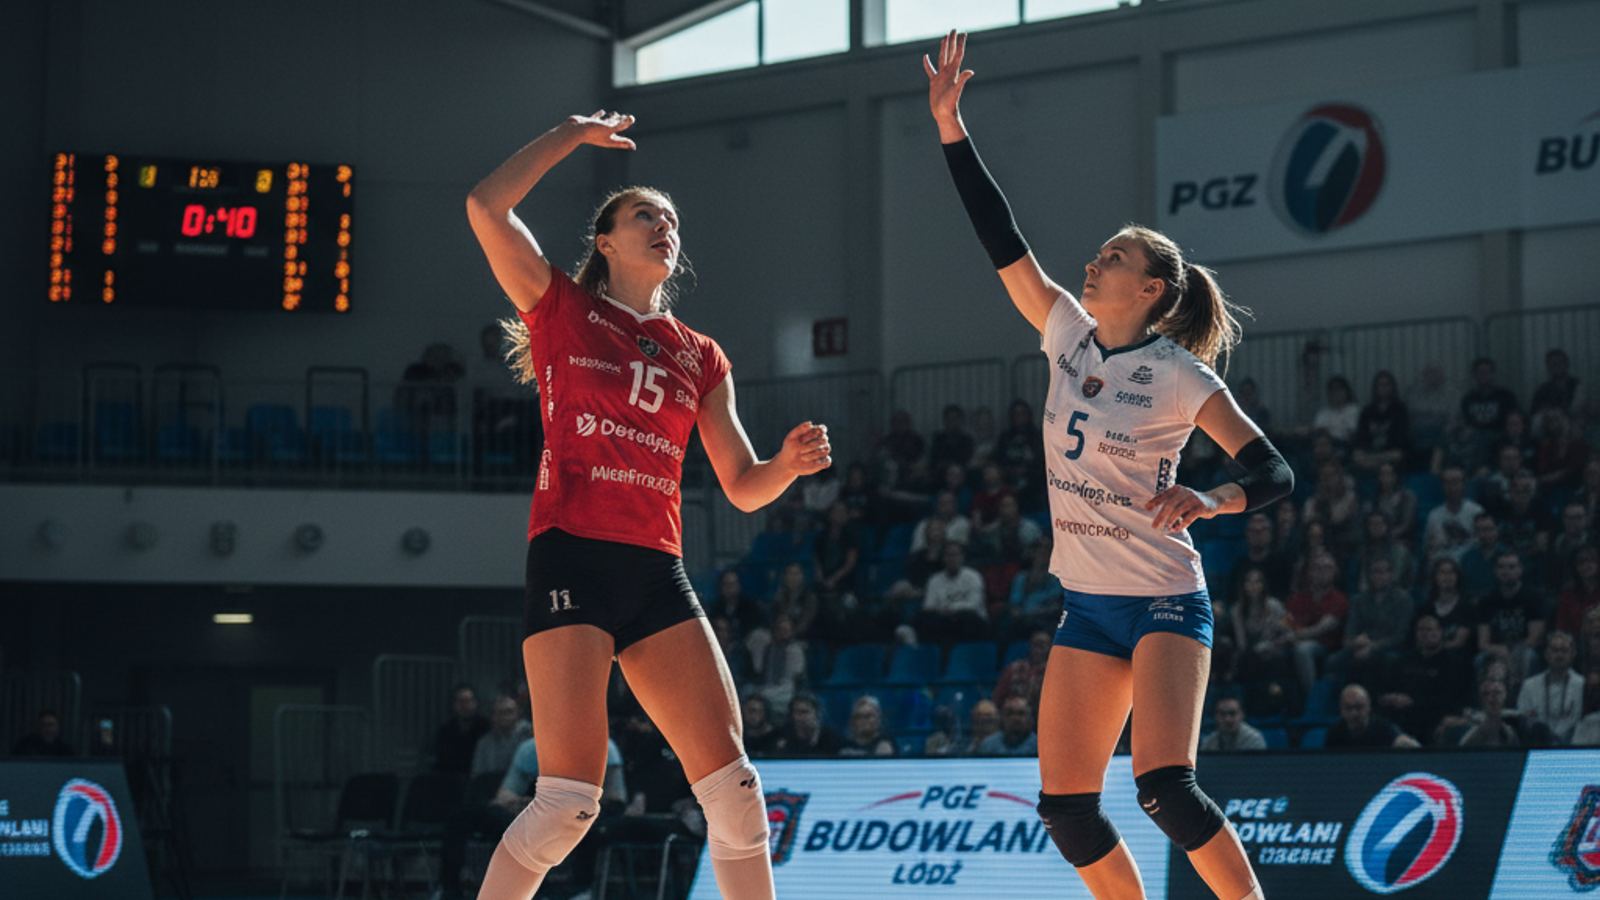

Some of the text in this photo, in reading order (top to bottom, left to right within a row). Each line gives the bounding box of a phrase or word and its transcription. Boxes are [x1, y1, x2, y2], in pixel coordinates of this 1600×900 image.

[1168, 173, 1258, 216] PGZ
[181, 203, 257, 238] 0:40
[628, 360, 669, 414] 15
[1065, 410, 1090, 460] 5
[919, 785, 988, 810] PGE
